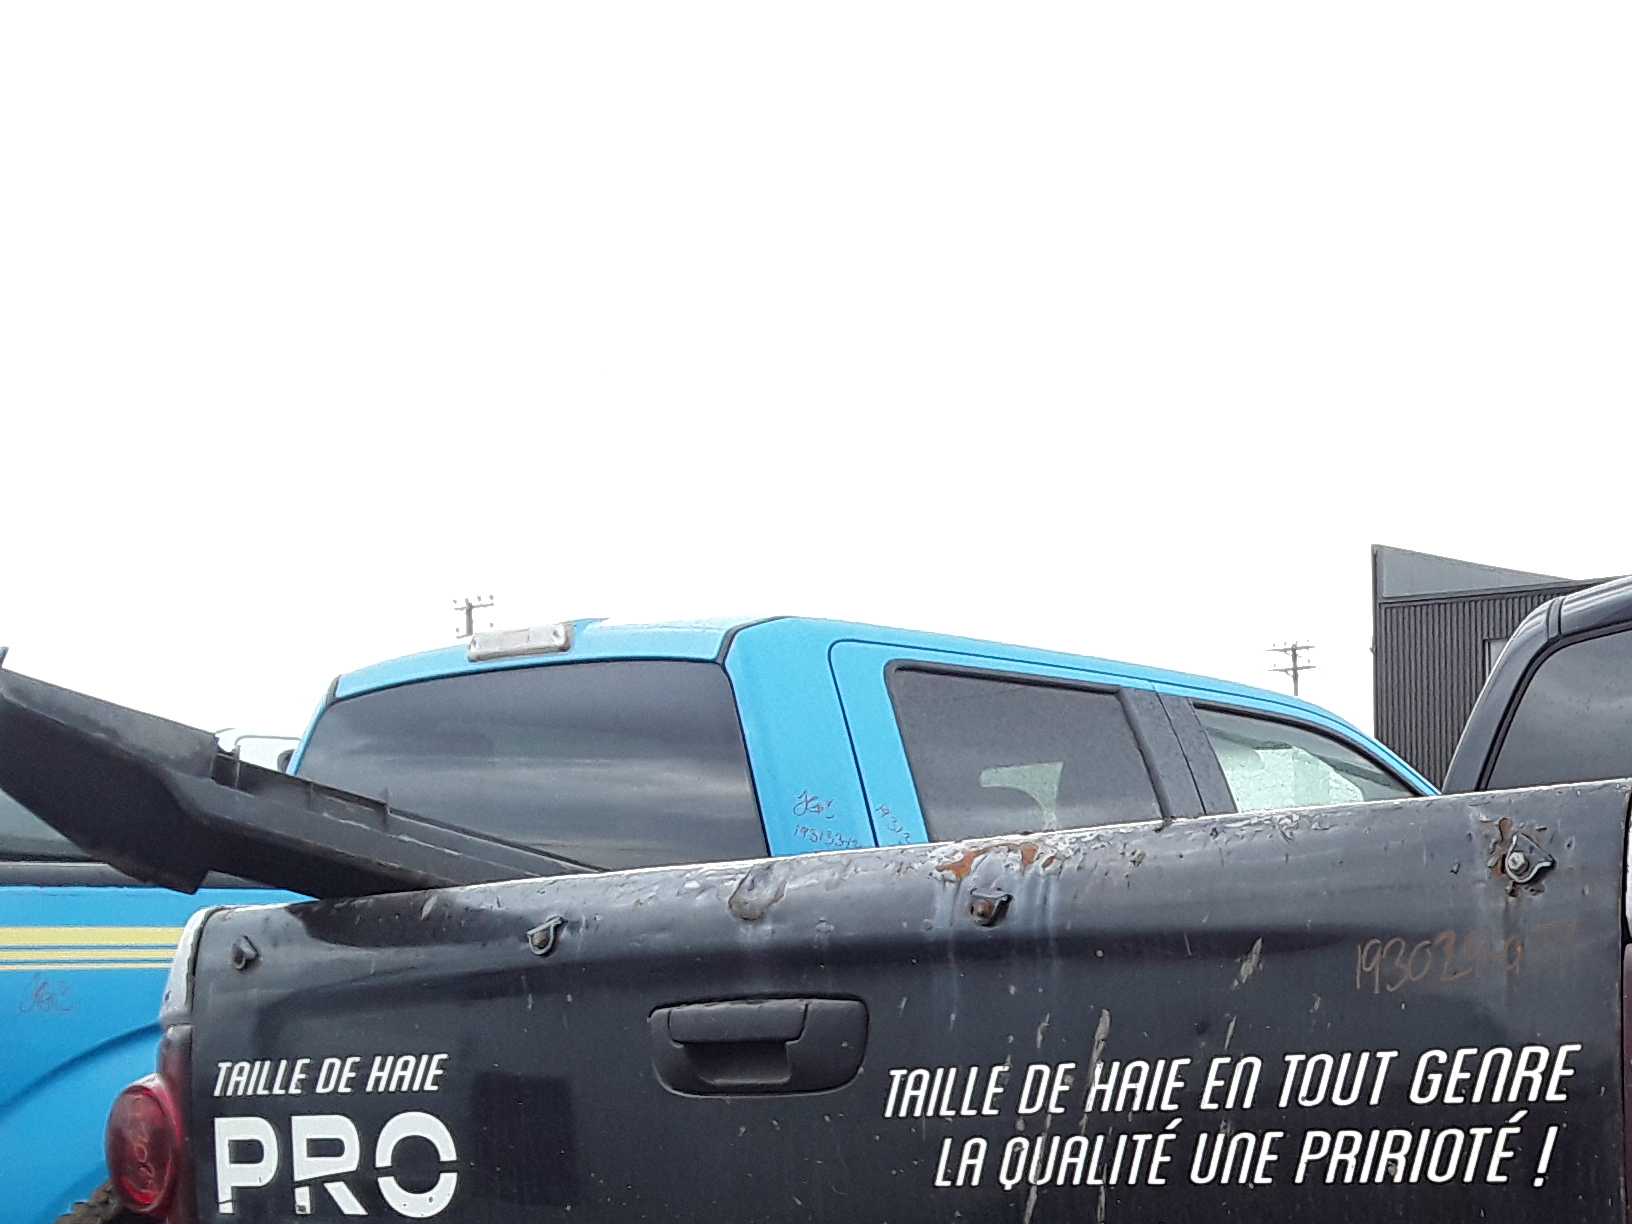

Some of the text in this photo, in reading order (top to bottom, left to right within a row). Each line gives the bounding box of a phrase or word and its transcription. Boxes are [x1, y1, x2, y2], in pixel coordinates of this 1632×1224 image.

[213, 1053, 448, 1096] TAILLE DE HAIE
[884, 1043, 1583, 1118] TAILLE DE HAIE EN TOUT GENRE
[213, 1112, 459, 1218] PRO
[934, 1138, 988, 1188] LA
[998, 1117, 1184, 1191] QUALITÉ
[1190, 1131, 1284, 1185] UNE
[1294, 1109, 1528, 1185] PRIRIOTÉ
